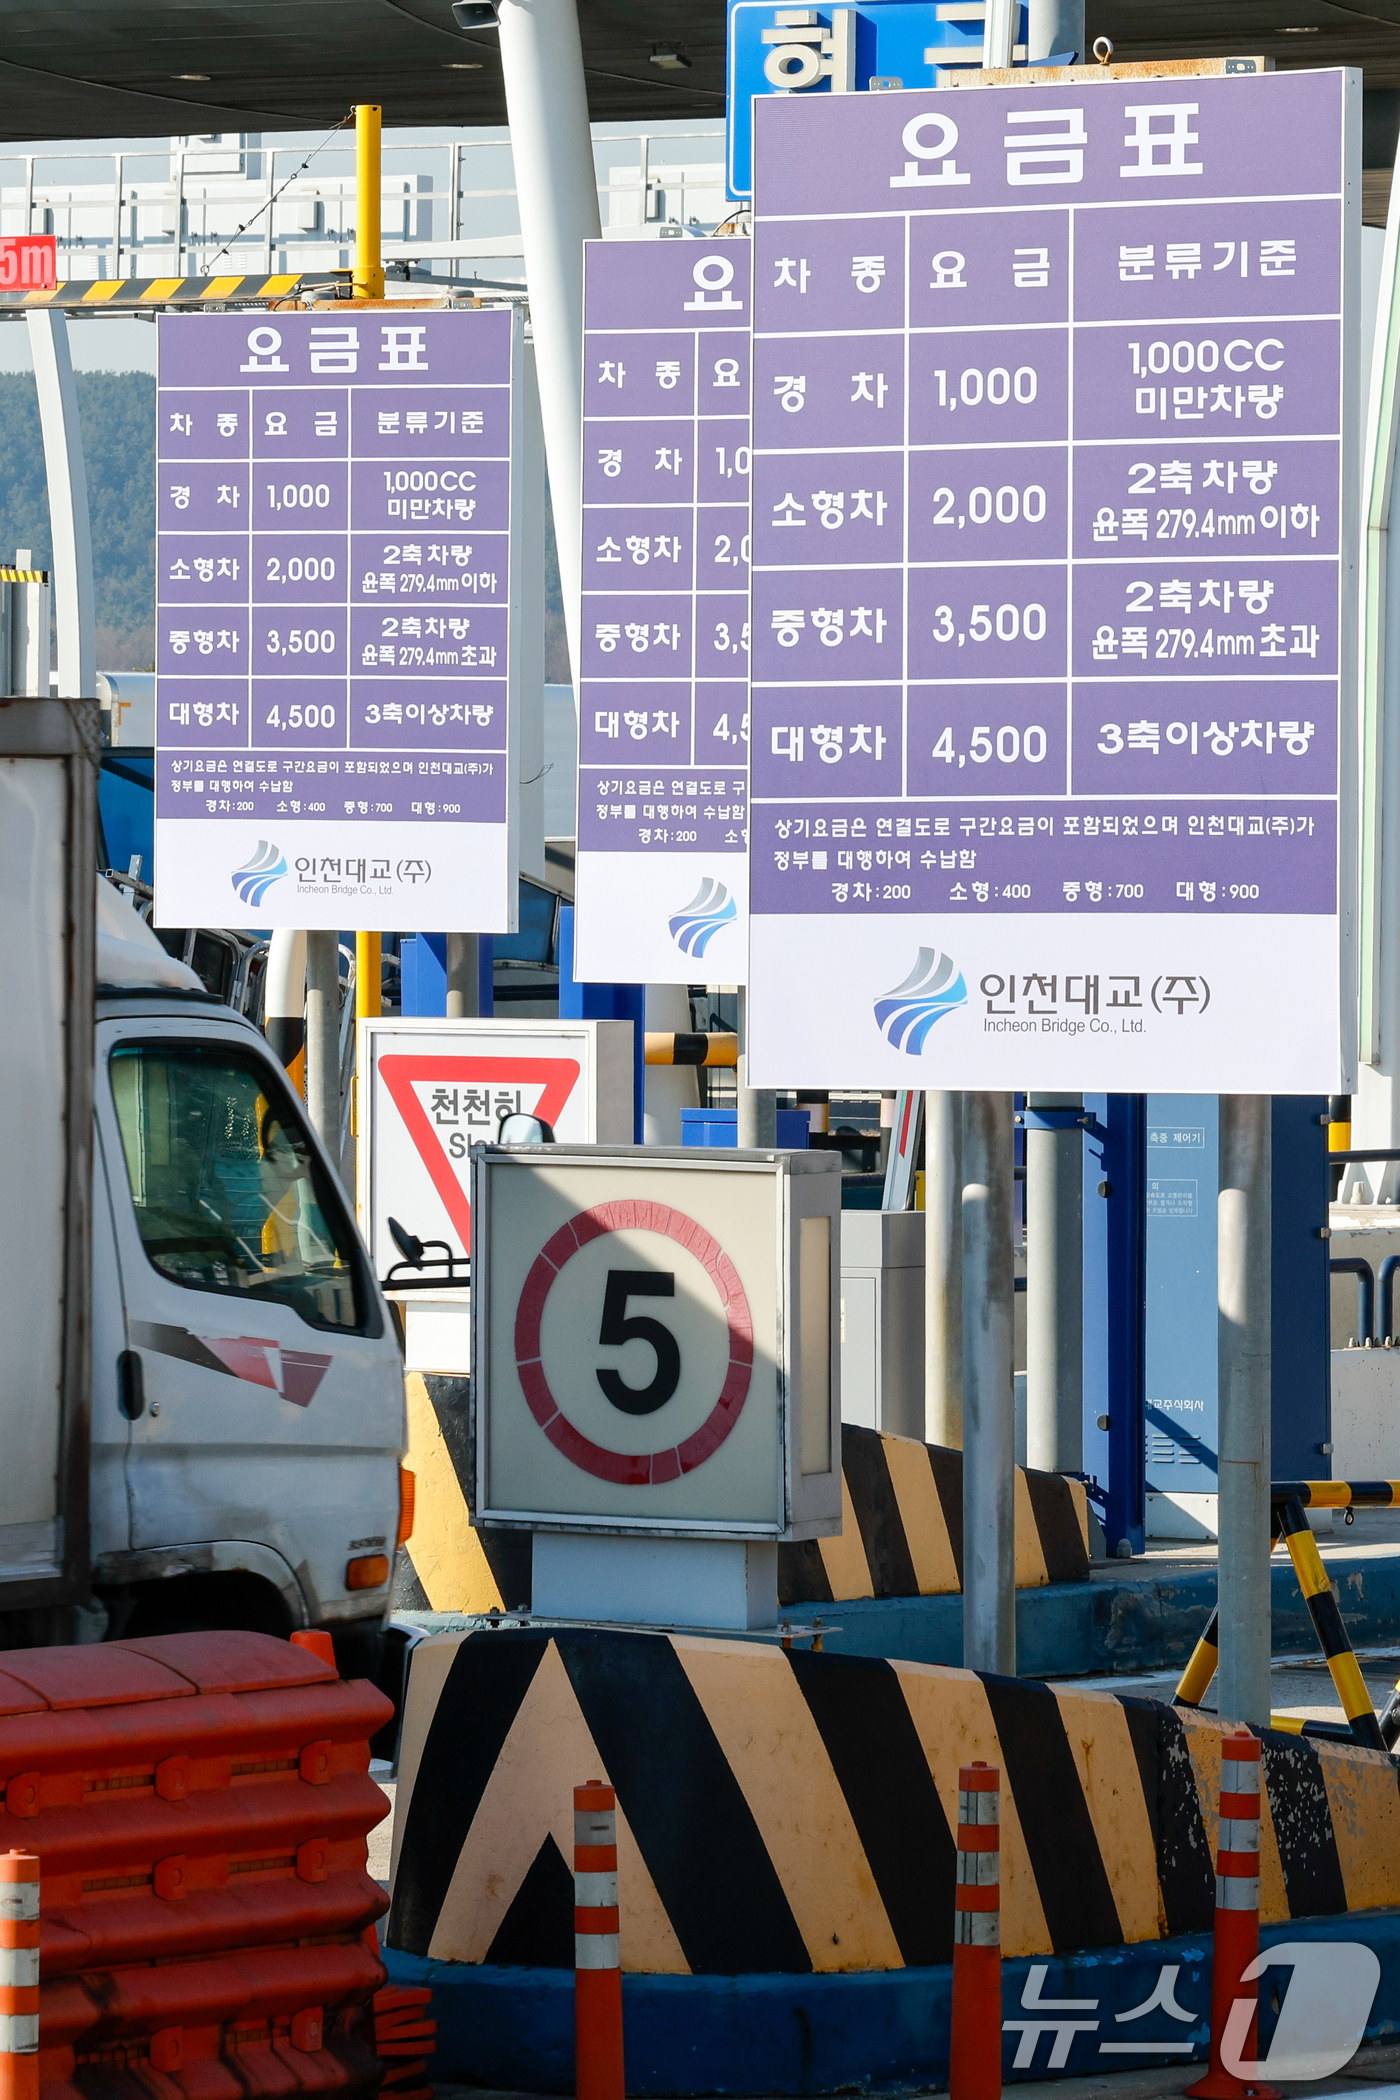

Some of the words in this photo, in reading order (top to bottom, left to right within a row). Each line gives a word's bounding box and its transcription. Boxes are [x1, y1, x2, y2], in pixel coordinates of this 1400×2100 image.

[890, 103, 1203, 188] 요금표
[1119, 240, 1296, 281] 분류기준
[240, 327, 428, 373] 요금표
[1129, 339, 1284, 378] 1,000CC
[934, 367, 1037, 411] 1,000
[1136, 384, 1283, 420] 미만차량
[378, 412, 483, 433] 분류기준
[384, 471, 476, 493] 1,000CC
[267, 484, 329, 510] 1,000
[388, 498, 476, 520] 미만차량
[772, 490, 887, 529] 소형차
[933, 485, 1045, 529] 2,000
[597, 535, 681, 565] 소형차
[170, 558, 239, 582] 소형차
[267, 558, 334, 583] 2,000
[596, 623, 680, 652] 중형차
[771, 607, 887, 647] 중형차
[933, 604, 1046, 647] 3,500
[169, 630, 239, 654] 중형차
[267, 630, 334, 656] 3,500
[170, 702, 239, 726] 대형차
[267, 705, 335, 730] 4,500
[595, 711, 679, 739] 대형차
[772, 724, 886, 763] 대형차
[933, 726, 1046, 768] 4,500
[172, 760, 227, 773] 상기요금은
[233, 761, 277, 772] 연결도로
[283, 761, 338, 773] 구간요금이
[345, 761, 412, 774] 포함되었으며
[172, 780, 203, 792] 정부를
[210, 780, 253, 793] 대행하여
[259, 781, 293, 792] 수납함
[597, 780, 664, 795] 상기요금은
[672, 781, 725, 795] 연결도로
[597, 805, 636, 819] 정부를
[643, 804, 696, 820] 대행하여
[704, 805, 745, 819] 수납함
[775, 818, 866, 838] 상기요금은
[877, 818, 950, 836] 연결도로
[960, 817, 1053, 836] 구간요금이
[1064, 816, 1177, 835] 포함되었으며
[1188, 815, 1314, 835] 인천대교(주)가
[295, 858, 431, 883] 인천대교(주)
[775, 851, 827, 870] 정부를
[838, 850, 910, 870] 대행하여
[921, 849, 976, 869] 수납함
[297, 884, 329, 894] Incheon
[331, 884, 358, 897] Bridge
[379, 885, 394, 896] Ltd.
[980, 973, 1210, 1014] 인천대교(주)
[985, 1018, 1036, 1032] Incheon
[1042, 1019, 1085, 1036] Bridge
[1090, 1018, 1116, 1034] Co.,
[1122, 1019, 1146, 1032] Ltd.
[431, 1089, 521, 1125] 천천히
[596, 1269, 680, 1415] 5
